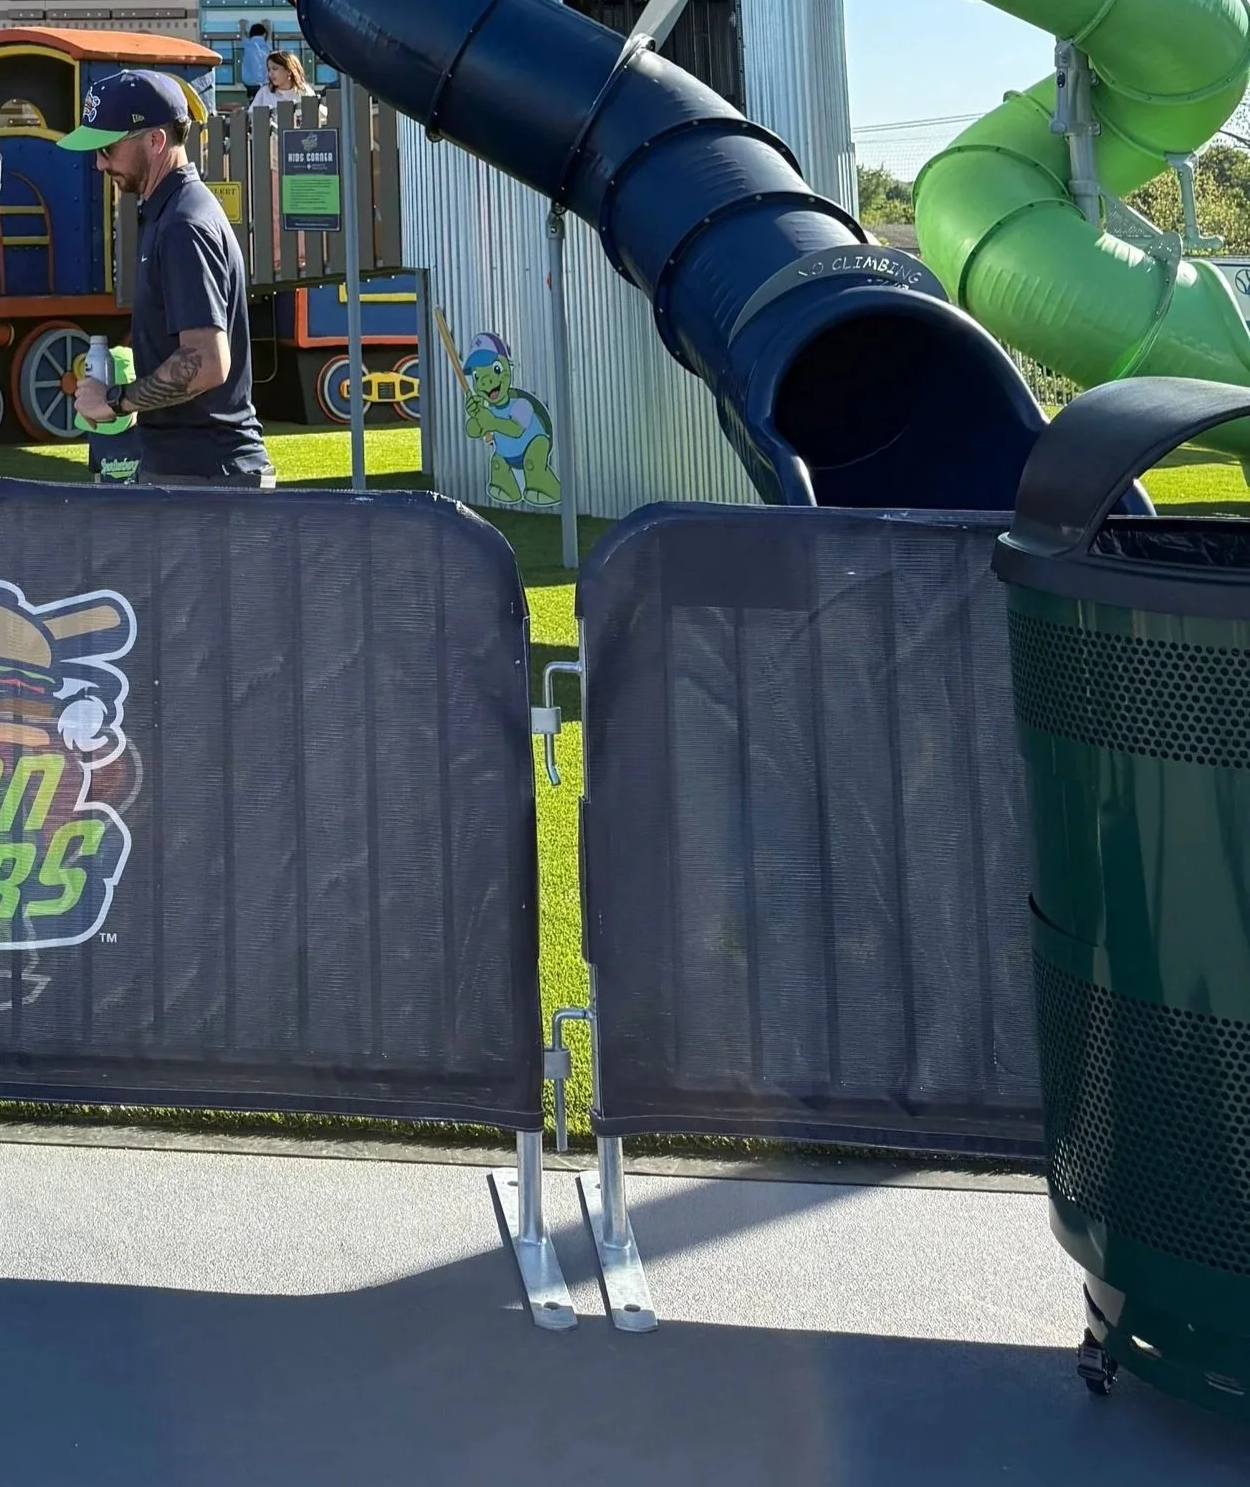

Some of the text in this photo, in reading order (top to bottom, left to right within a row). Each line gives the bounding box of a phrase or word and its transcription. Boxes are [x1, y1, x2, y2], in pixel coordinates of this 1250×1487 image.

[288, 152, 333, 163] KIDS CORNER
[831, 256, 922, 283] CLIMBING
[99, 932, 118, 943] TM
